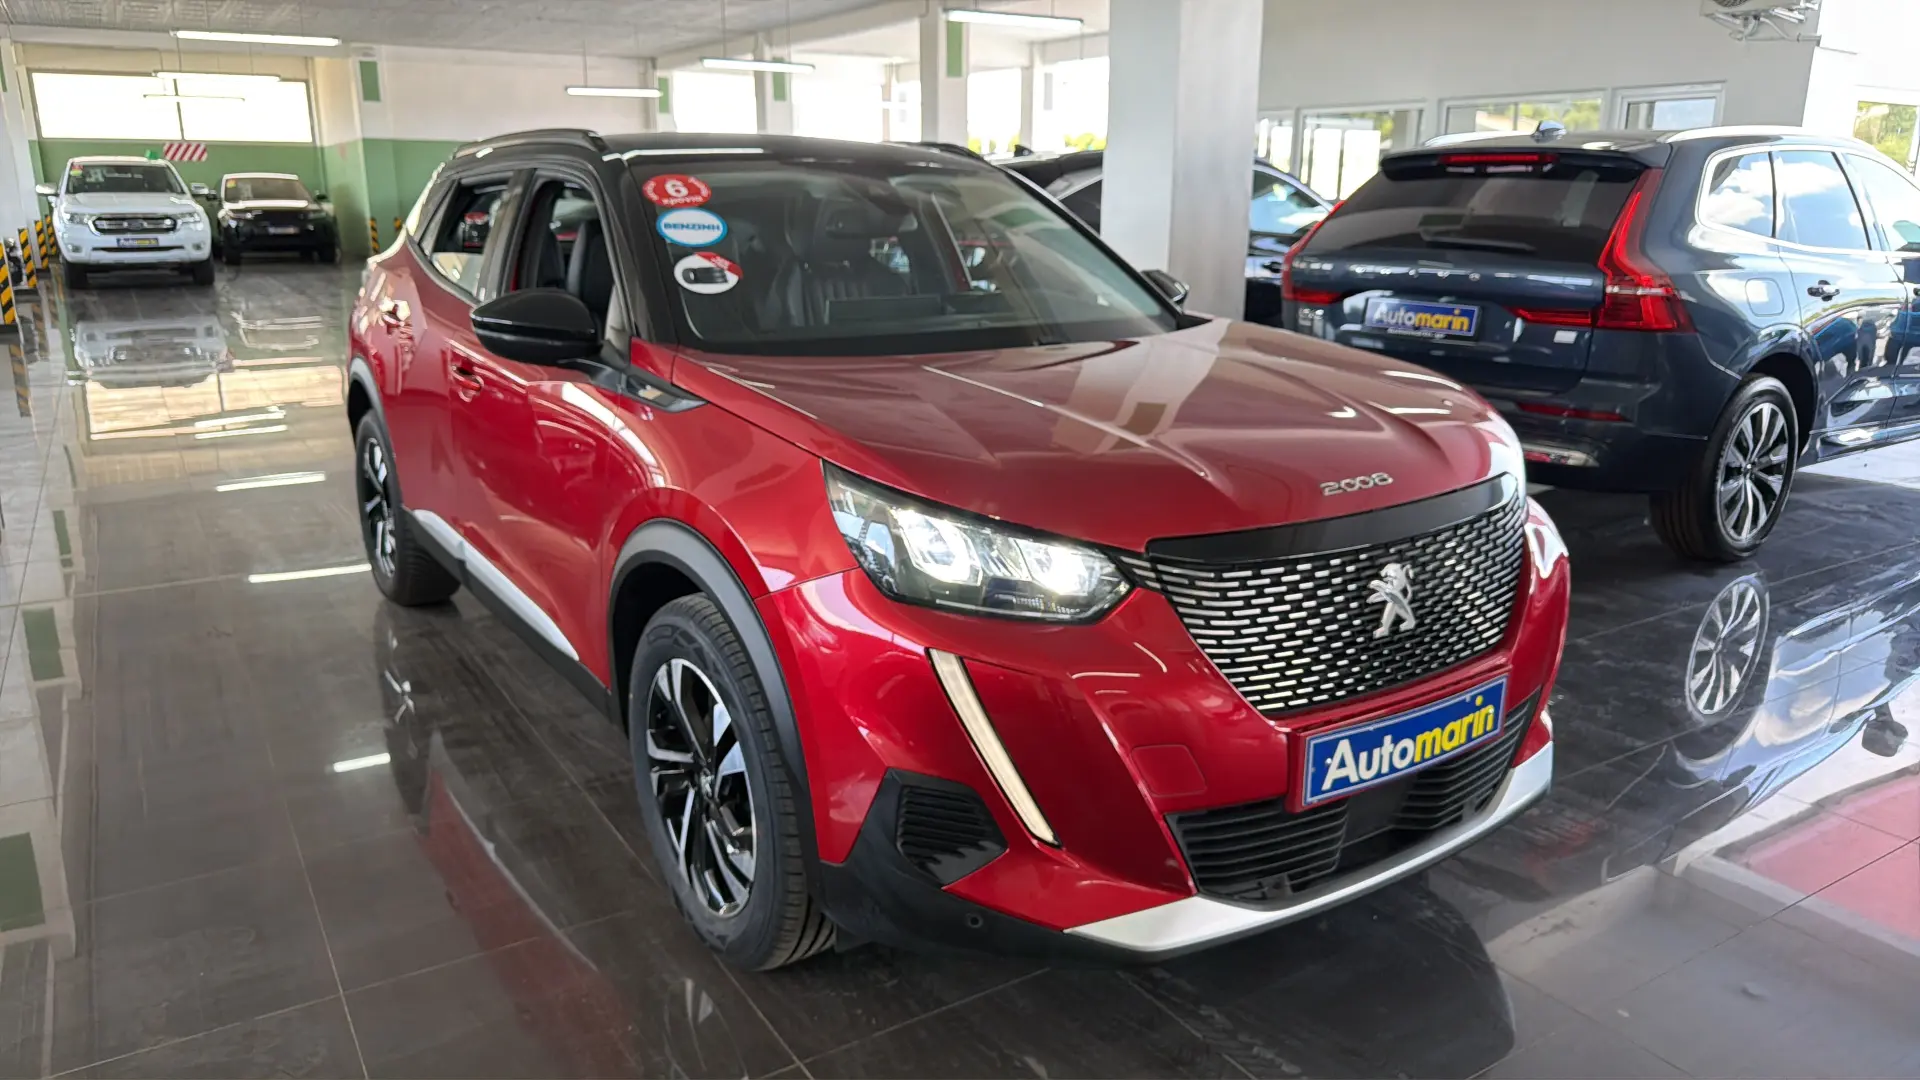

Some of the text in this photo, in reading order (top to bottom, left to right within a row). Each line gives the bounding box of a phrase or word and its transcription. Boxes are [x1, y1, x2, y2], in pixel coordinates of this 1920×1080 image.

[664, 179, 689, 198] 6
[1373, 301, 1470, 332] Automarin
[1320, 472, 1393, 496] 2008
[1321, 695, 1495, 791] Automarin
